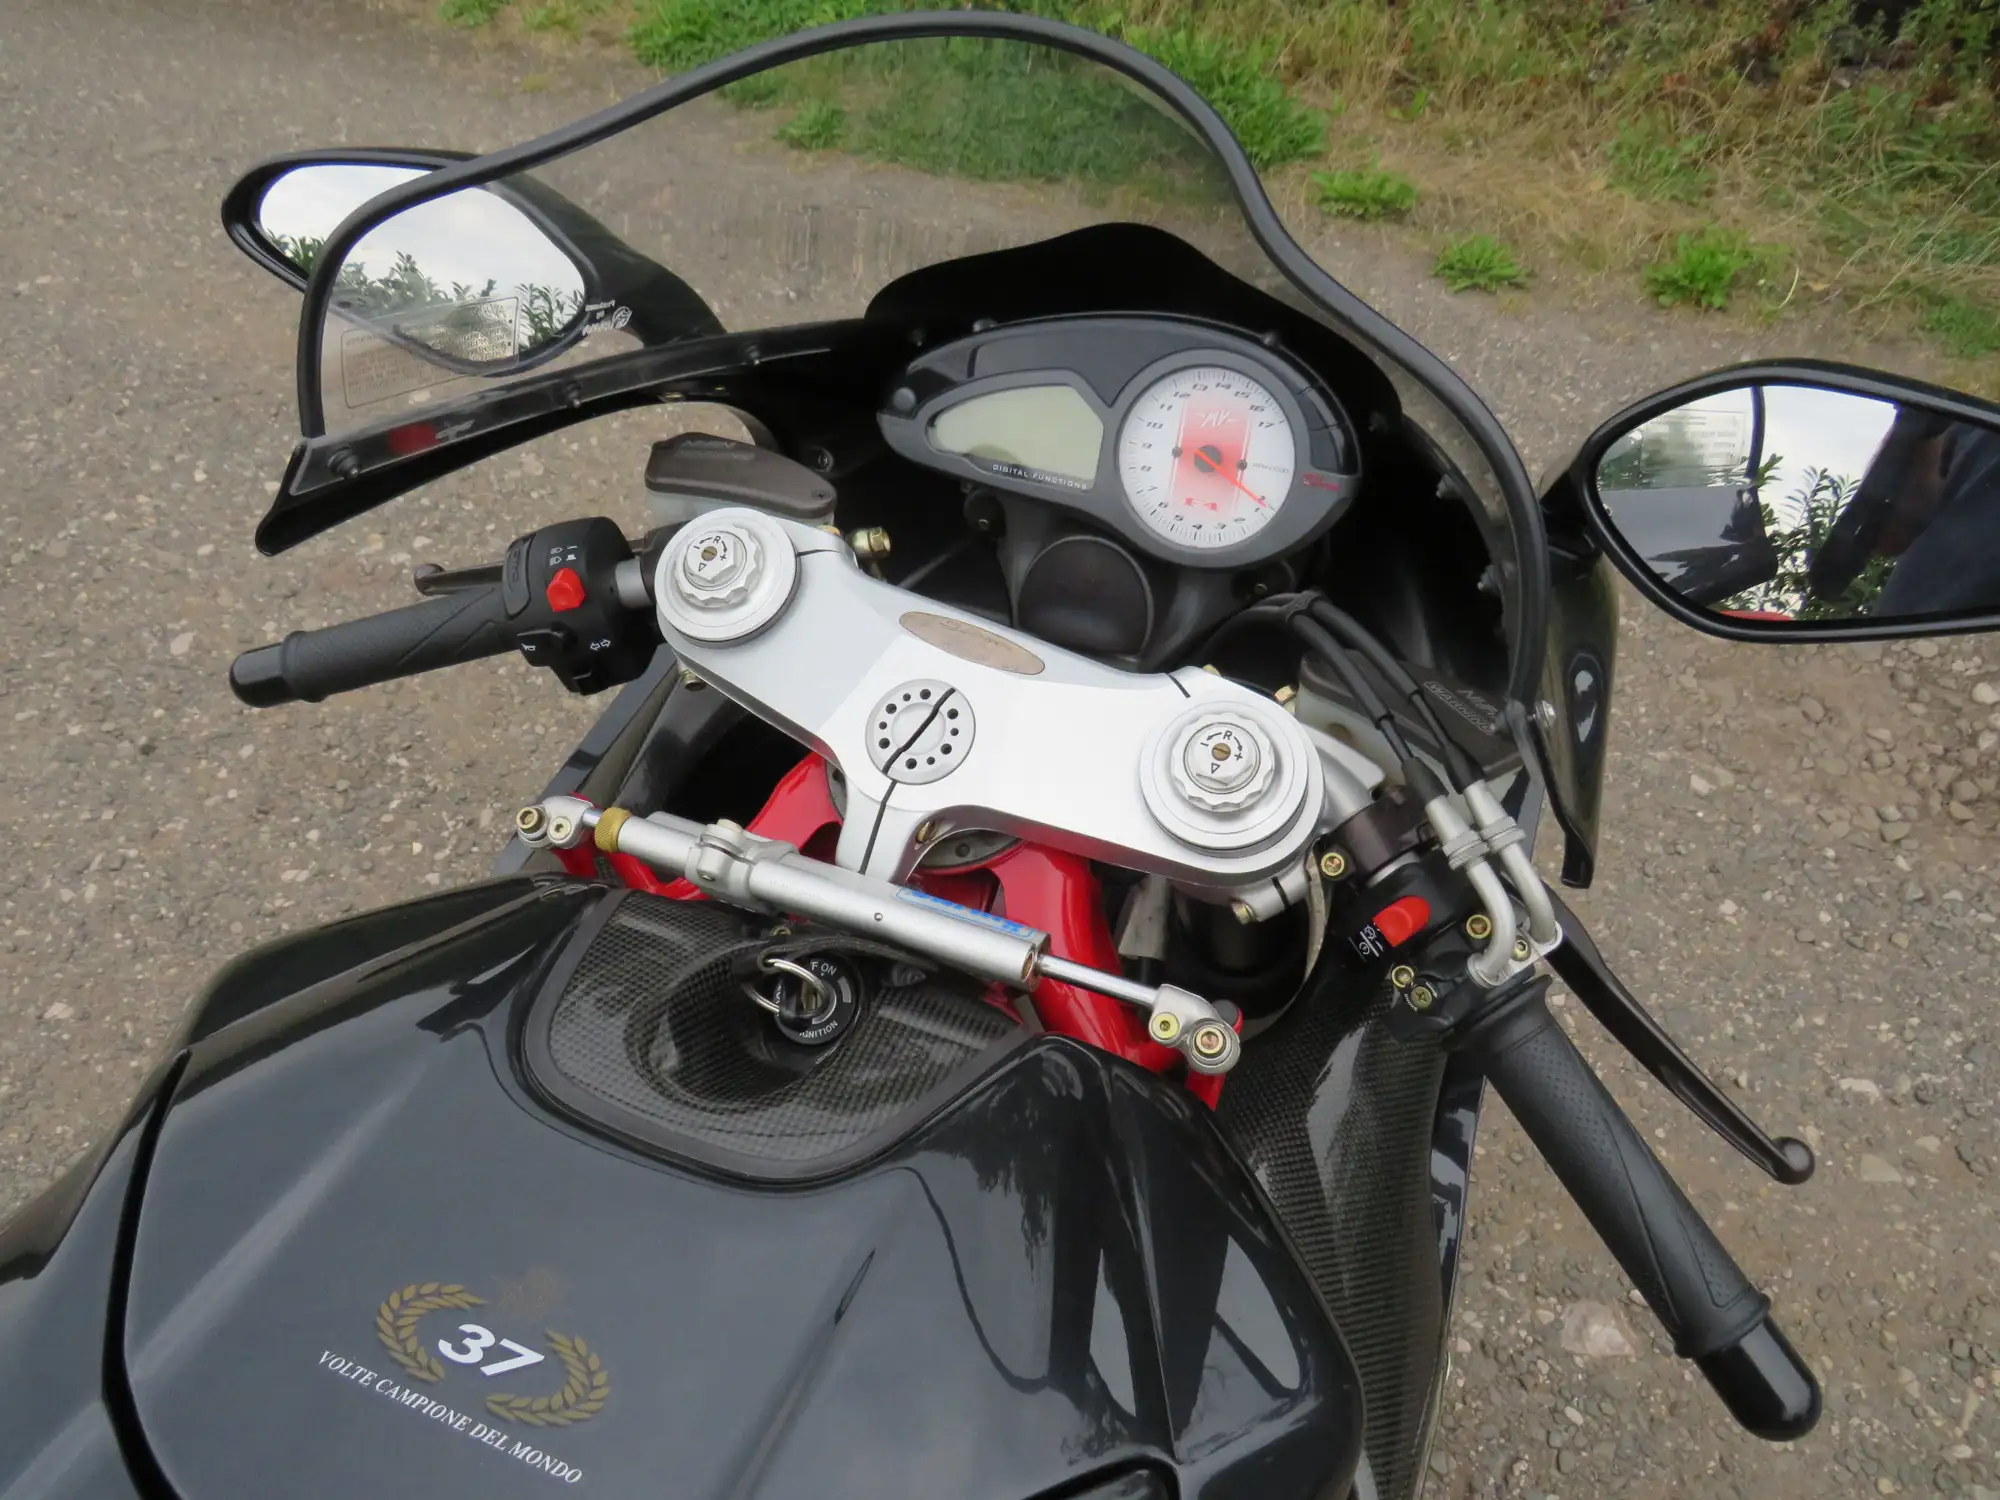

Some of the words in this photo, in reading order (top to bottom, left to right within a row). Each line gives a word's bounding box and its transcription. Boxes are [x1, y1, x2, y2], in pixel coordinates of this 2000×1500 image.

[992, 463, 1029, 478] DIGITAL
[1032, 472, 1087, 490] FUNCTIONS
[713, 535, 722, 545] R
[1222, 730, 1232, 740] R
[821, 962, 837, 976] ON
[438, 1323, 545, 1377] 37
[317, 1350, 378, 1386] VOLTE
[375, 1378, 473, 1432] CAMPIONE
[469, 1422, 507, 1453] DEL
[507, 1441, 583, 1484] MONDO
